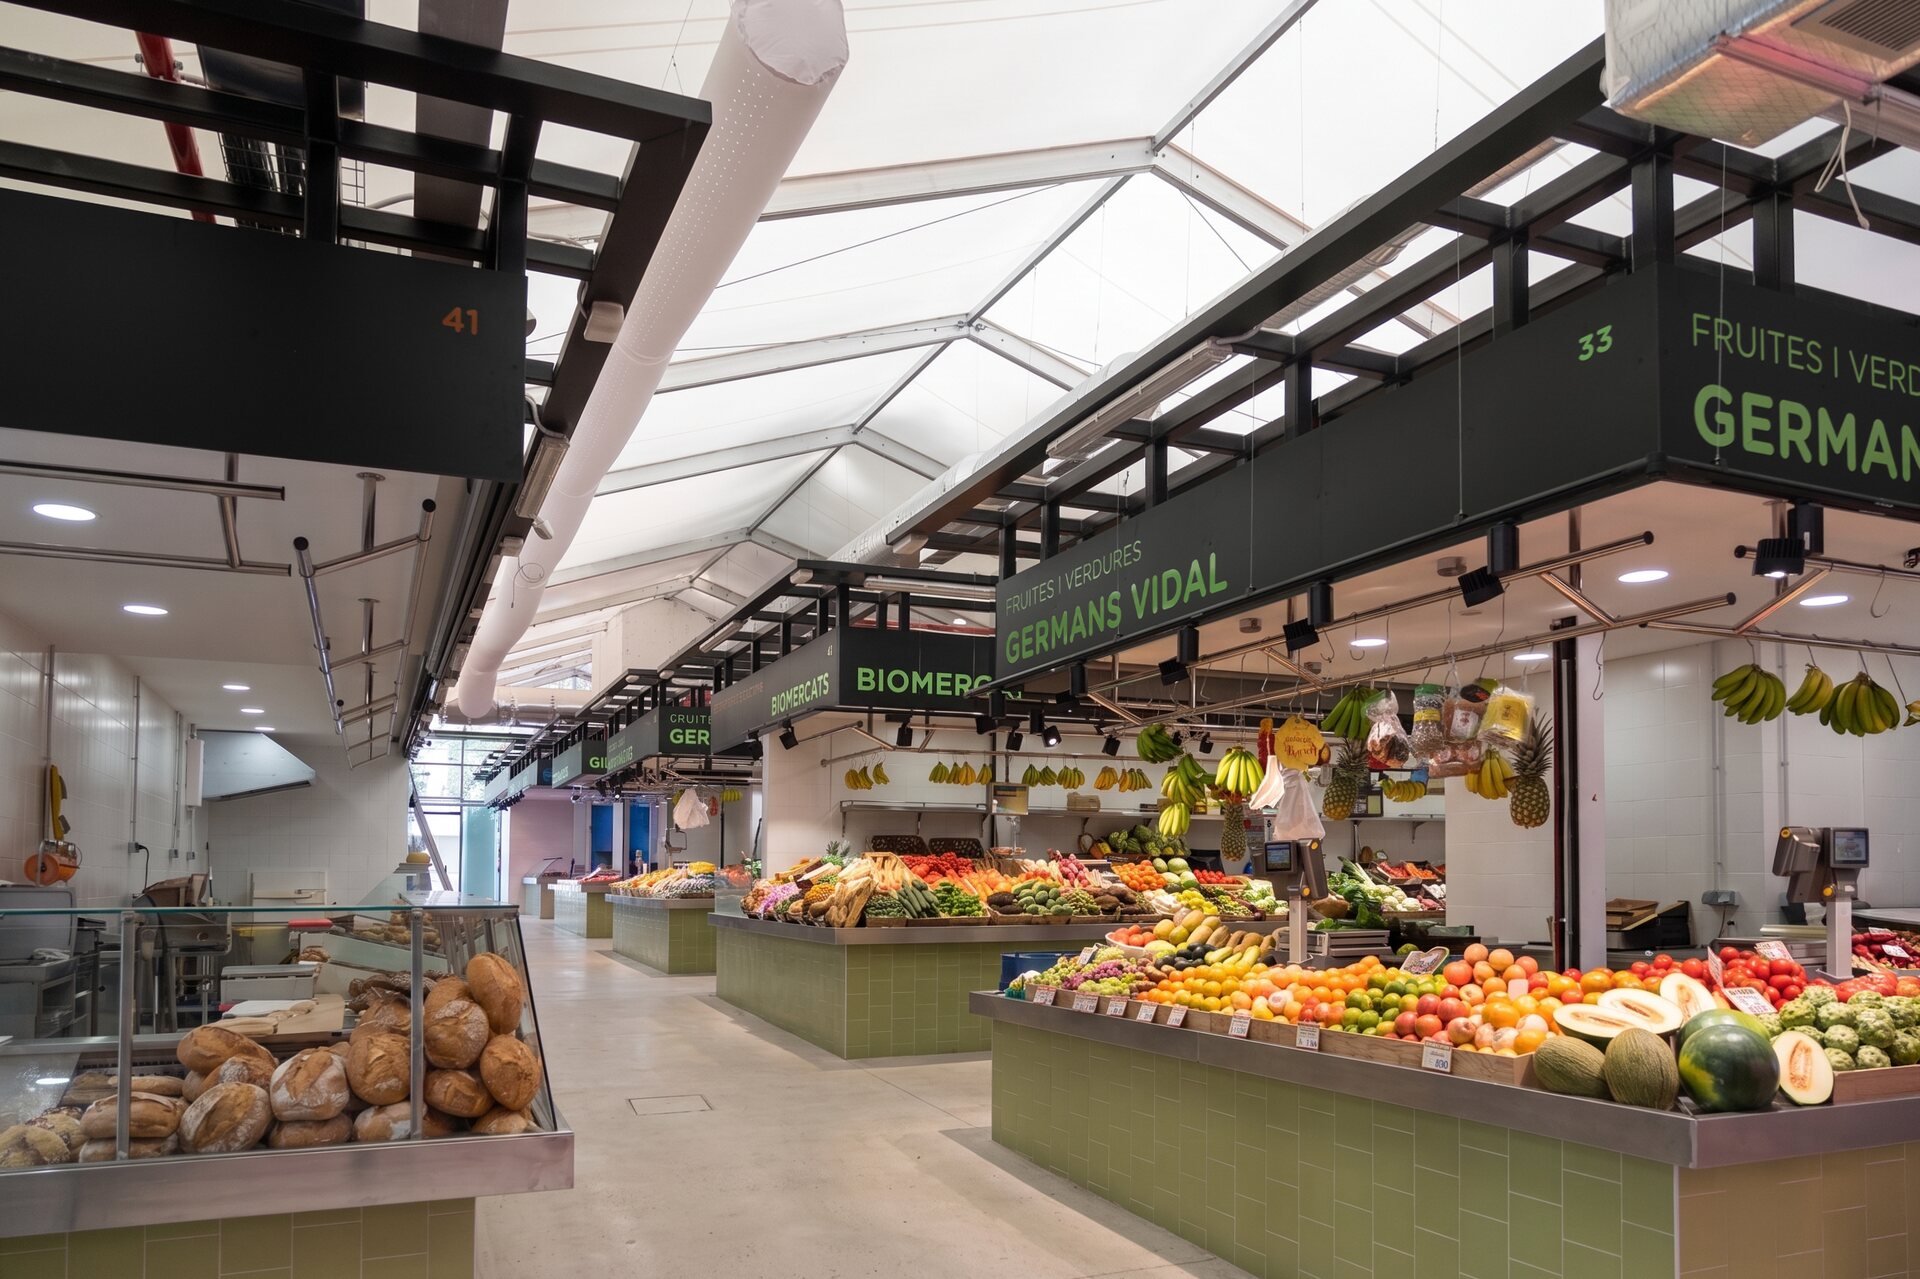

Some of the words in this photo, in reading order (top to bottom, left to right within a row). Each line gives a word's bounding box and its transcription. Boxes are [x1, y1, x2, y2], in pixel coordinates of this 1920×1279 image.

[441, 305, 479, 336] 41
[1577, 323, 1614, 362] 33
[1692, 312, 1823, 375] FRUITES
[1005, 579, 1055, 616] FRUITES
[1064, 539, 1143, 591] VERDURES
[1005, 590, 1122, 665] GERMANS
[1130, 551, 1229, 620] VIDAL
[771, 672, 830, 717] BIOMERCATS
[669, 728, 710, 746] GER
